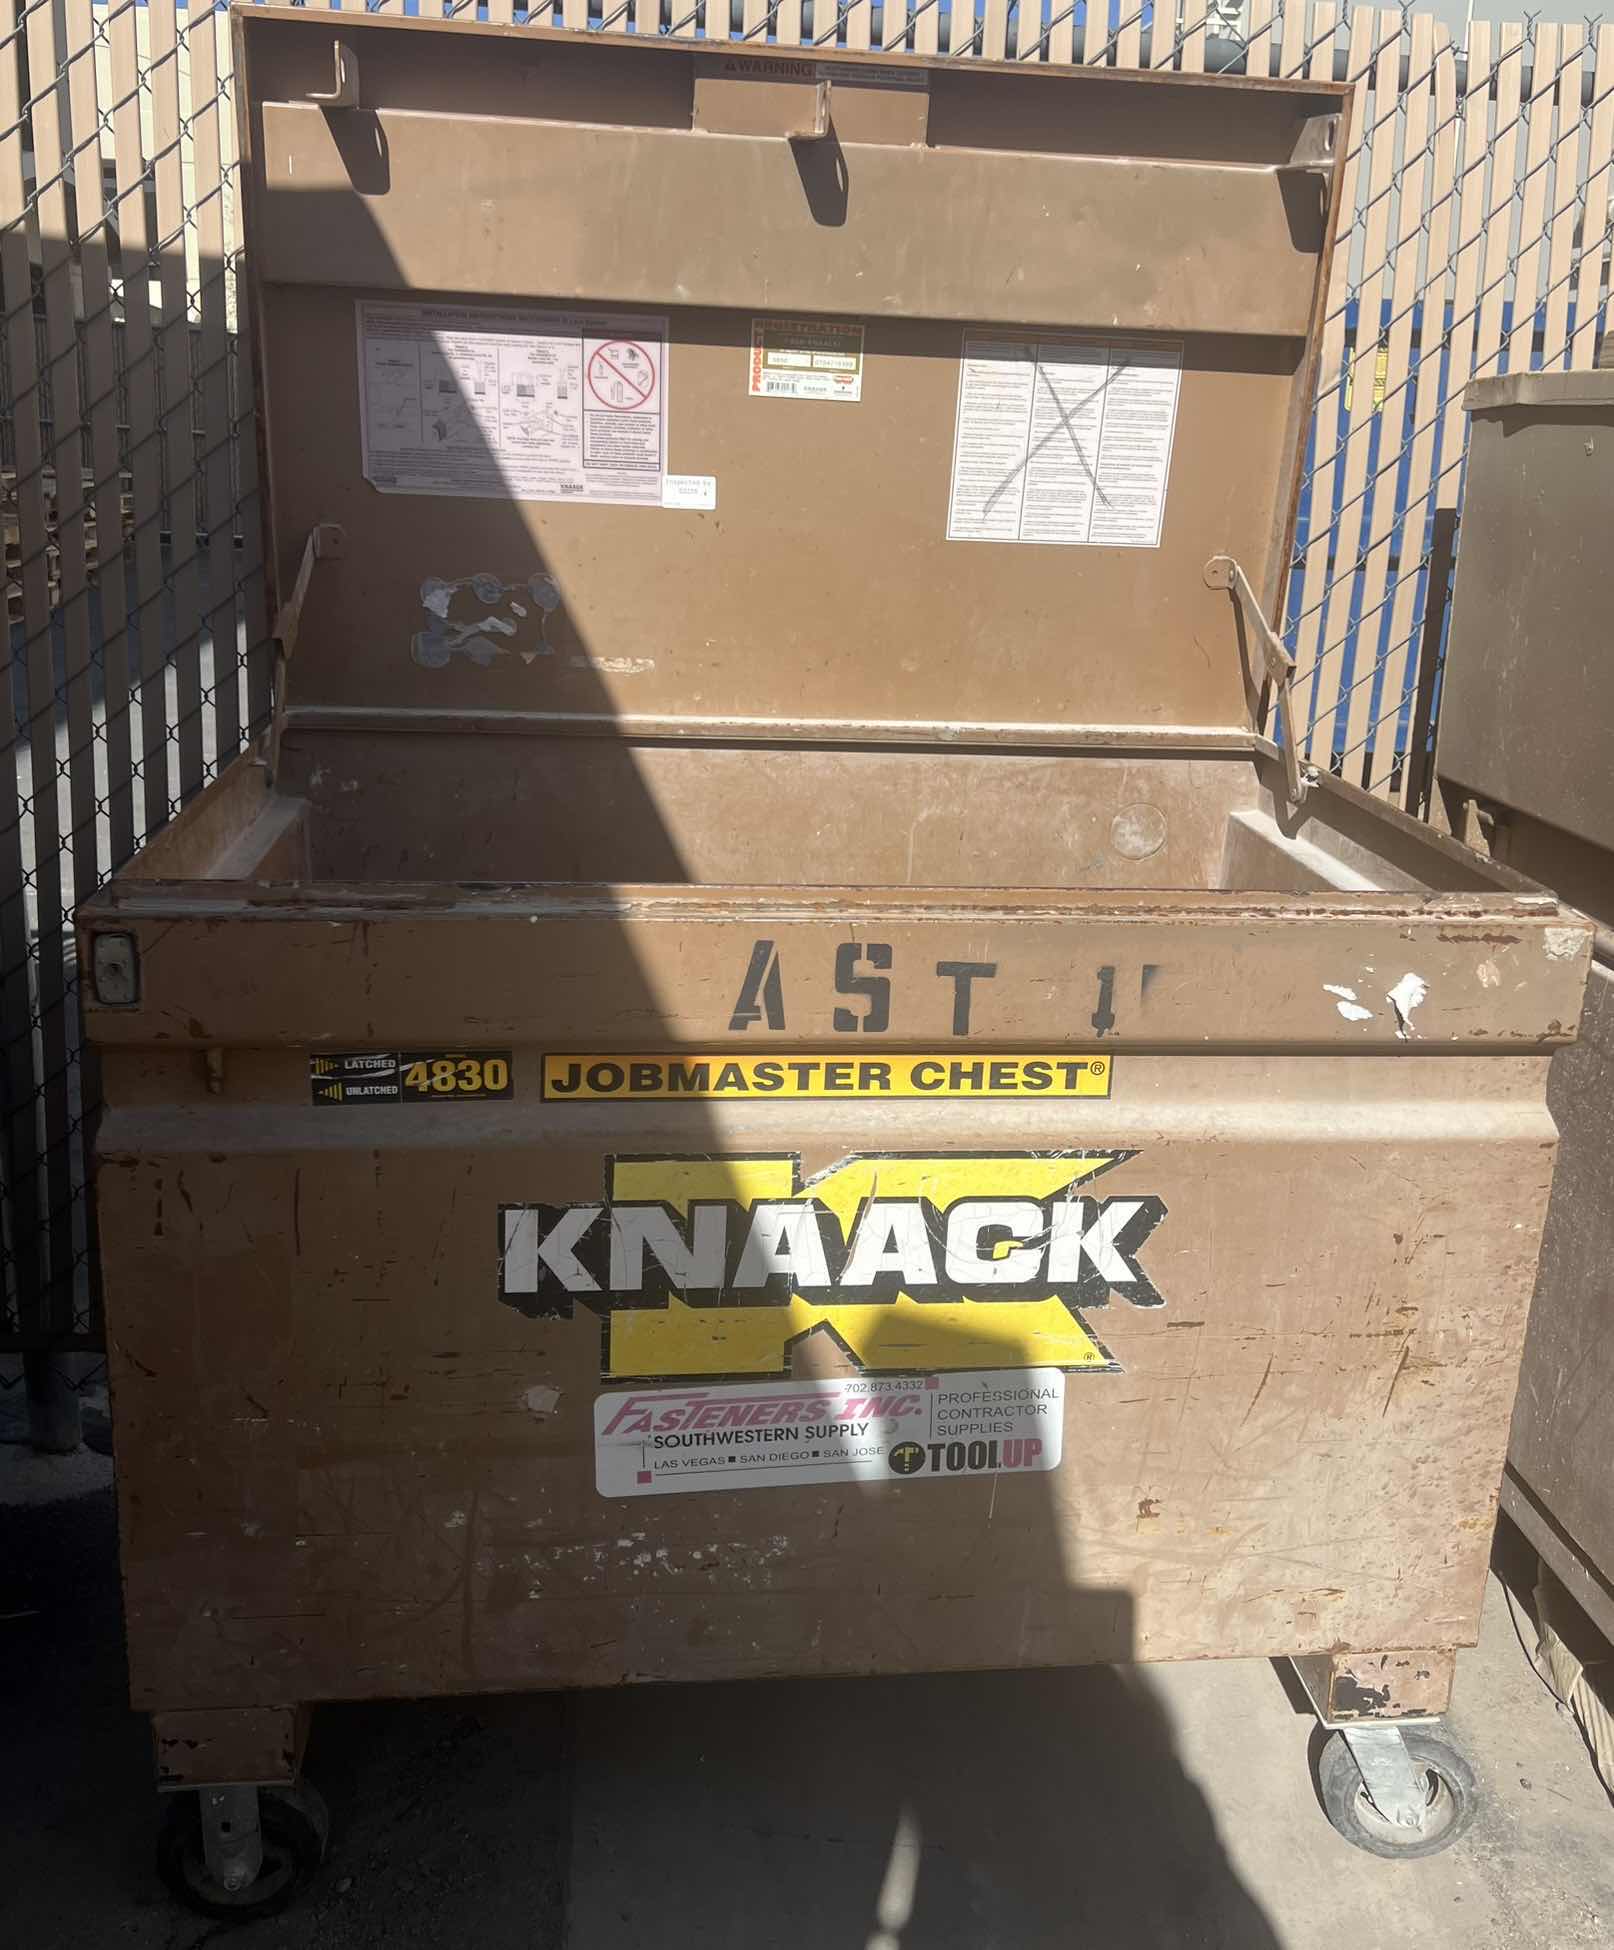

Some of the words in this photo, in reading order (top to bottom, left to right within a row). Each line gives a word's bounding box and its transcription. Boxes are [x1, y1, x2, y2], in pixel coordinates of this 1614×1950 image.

[738, 59, 813, 77] WARNING
[344, 1059, 396, 1069] LATCHED
[404, 1059, 508, 1092] 4830
[551, 1060, 892, 1094] JOBMASTER
[346, 1086, 398, 1096] UNLATCHED
[502, 1199, 1148, 1294] KNAACK
[937, 1387, 1059, 1405] PROFESSIONAL
[602, 1392, 840, 1436] FASTENERS
[833, 1393, 922, 1420] INC.
[937, 1404, 1048, 1421] CONTRACTOR
[654, 1426, 799, 1449] SOUTHWESTERN
[805, 1422, 869, 1440] SUPPLY
[937, 1421, 1014, 1437] SUPPLIES
[654, 1460, 678, 1470] LAS
[682, 1456, 725, 1467] VEGAS
[740, 1453, 765, 1463] SAN
[770, 1451, 809, 1461] DIEGO
[823, 1448, 849, 1458] SAN
[852, 1446, 885, 1456] JOSE
